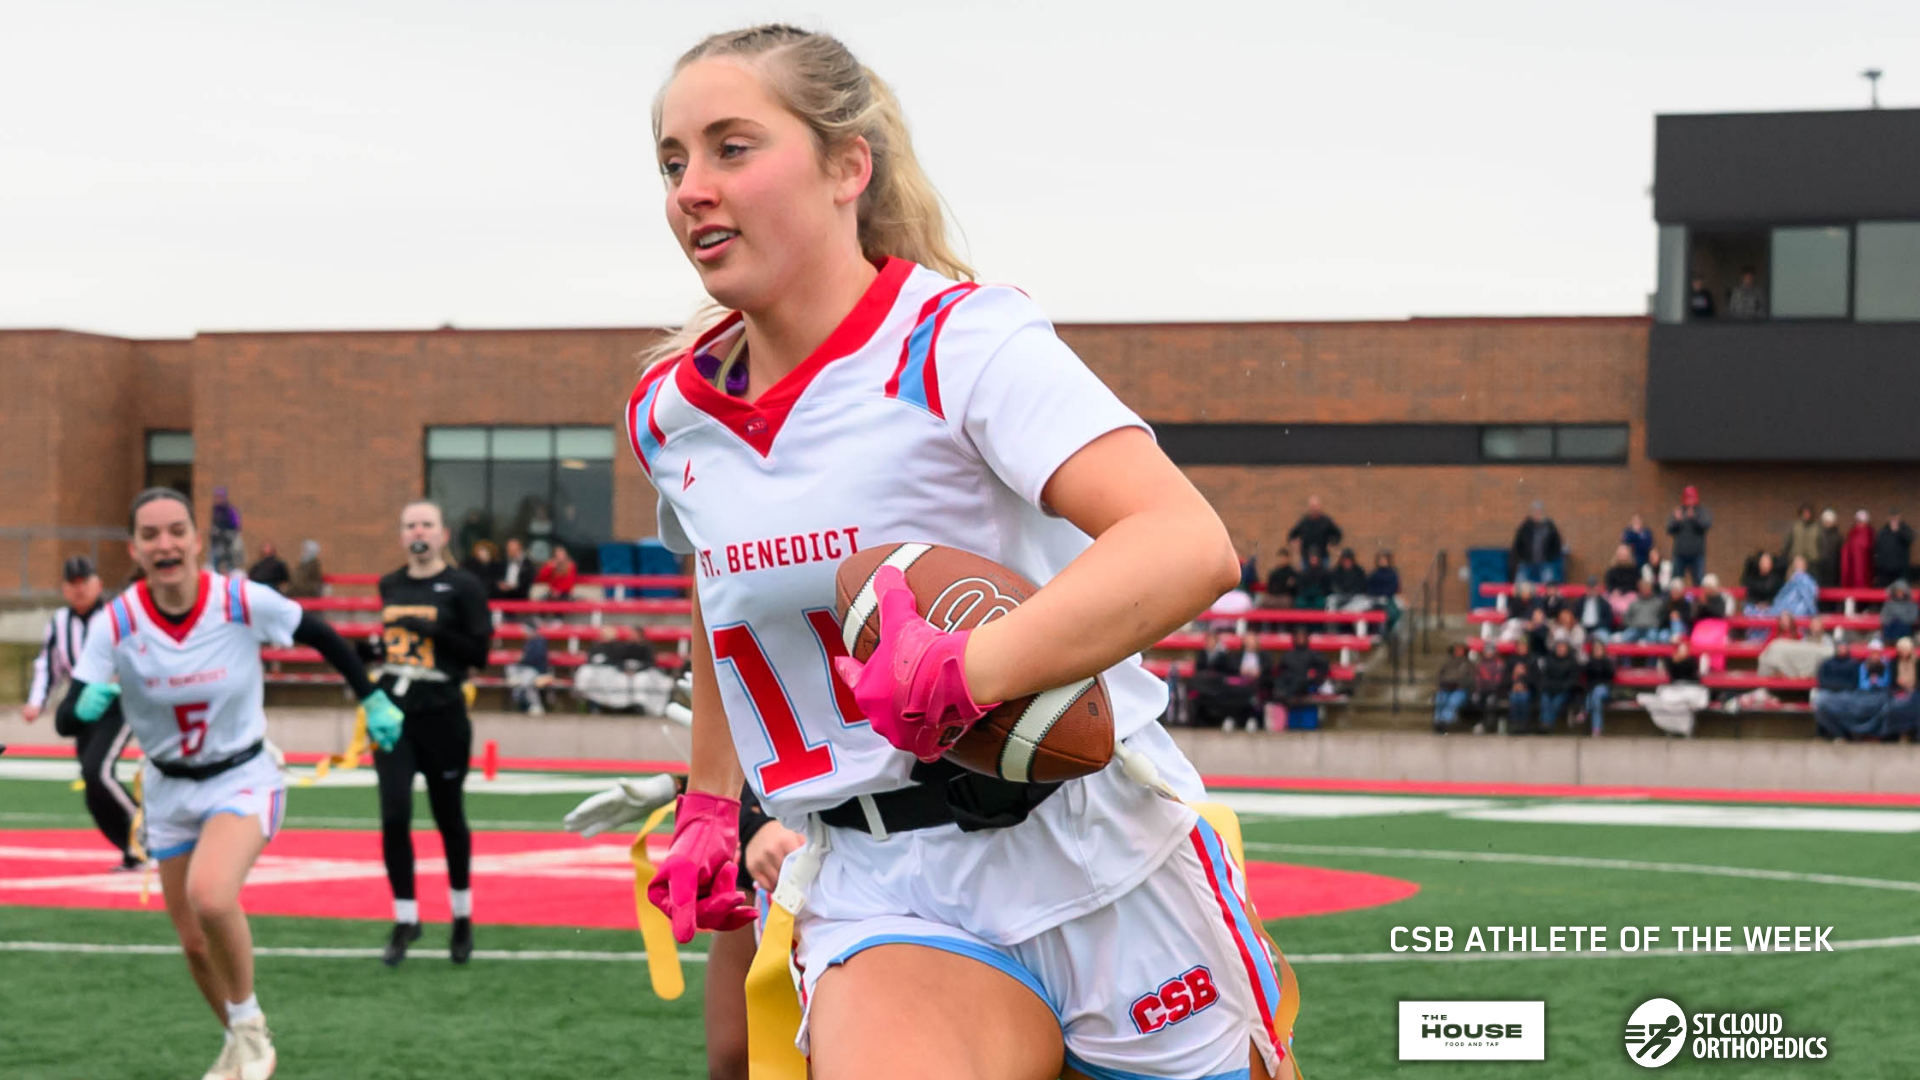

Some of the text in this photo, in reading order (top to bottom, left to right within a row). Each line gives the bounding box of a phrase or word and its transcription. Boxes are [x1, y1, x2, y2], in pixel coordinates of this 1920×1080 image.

[726, 526, 859, 573] BENEDICT
[173, 701, 209, 757] 5
[1129, 965, 1220, 1034] CSB
